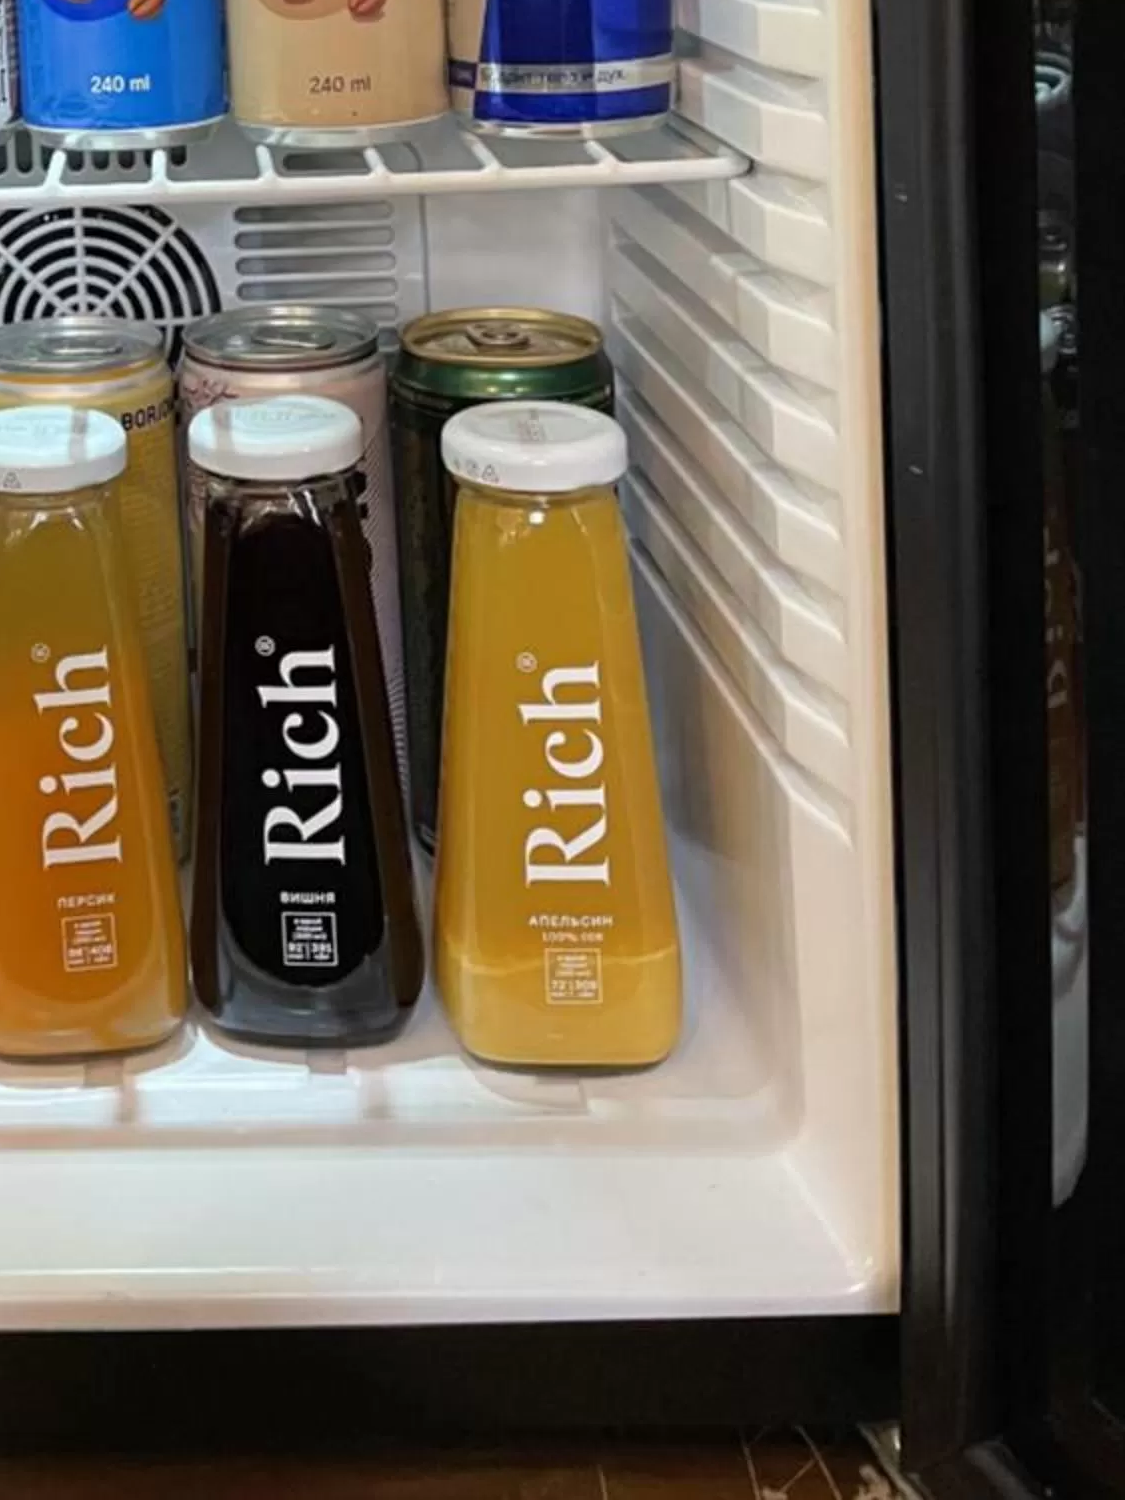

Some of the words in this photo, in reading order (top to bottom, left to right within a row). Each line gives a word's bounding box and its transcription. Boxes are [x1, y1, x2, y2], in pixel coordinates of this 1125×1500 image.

[90, 75, 124, 94] 240
[129, 74, 151, 93] ml
[309, 76, 345, 94] 240
[350, 75, 372, 93] ml
[33, 644, 123, 870] Rich
[255, 643, 347, 867] Rich
[517, 659, 612, 889] Rich
[57, 892, 116, 911] ПЕРСИК
[279, 890, 337, 905] ВИШНЯ
[528, 914, 614, 928] АПЕЛЬСИН
